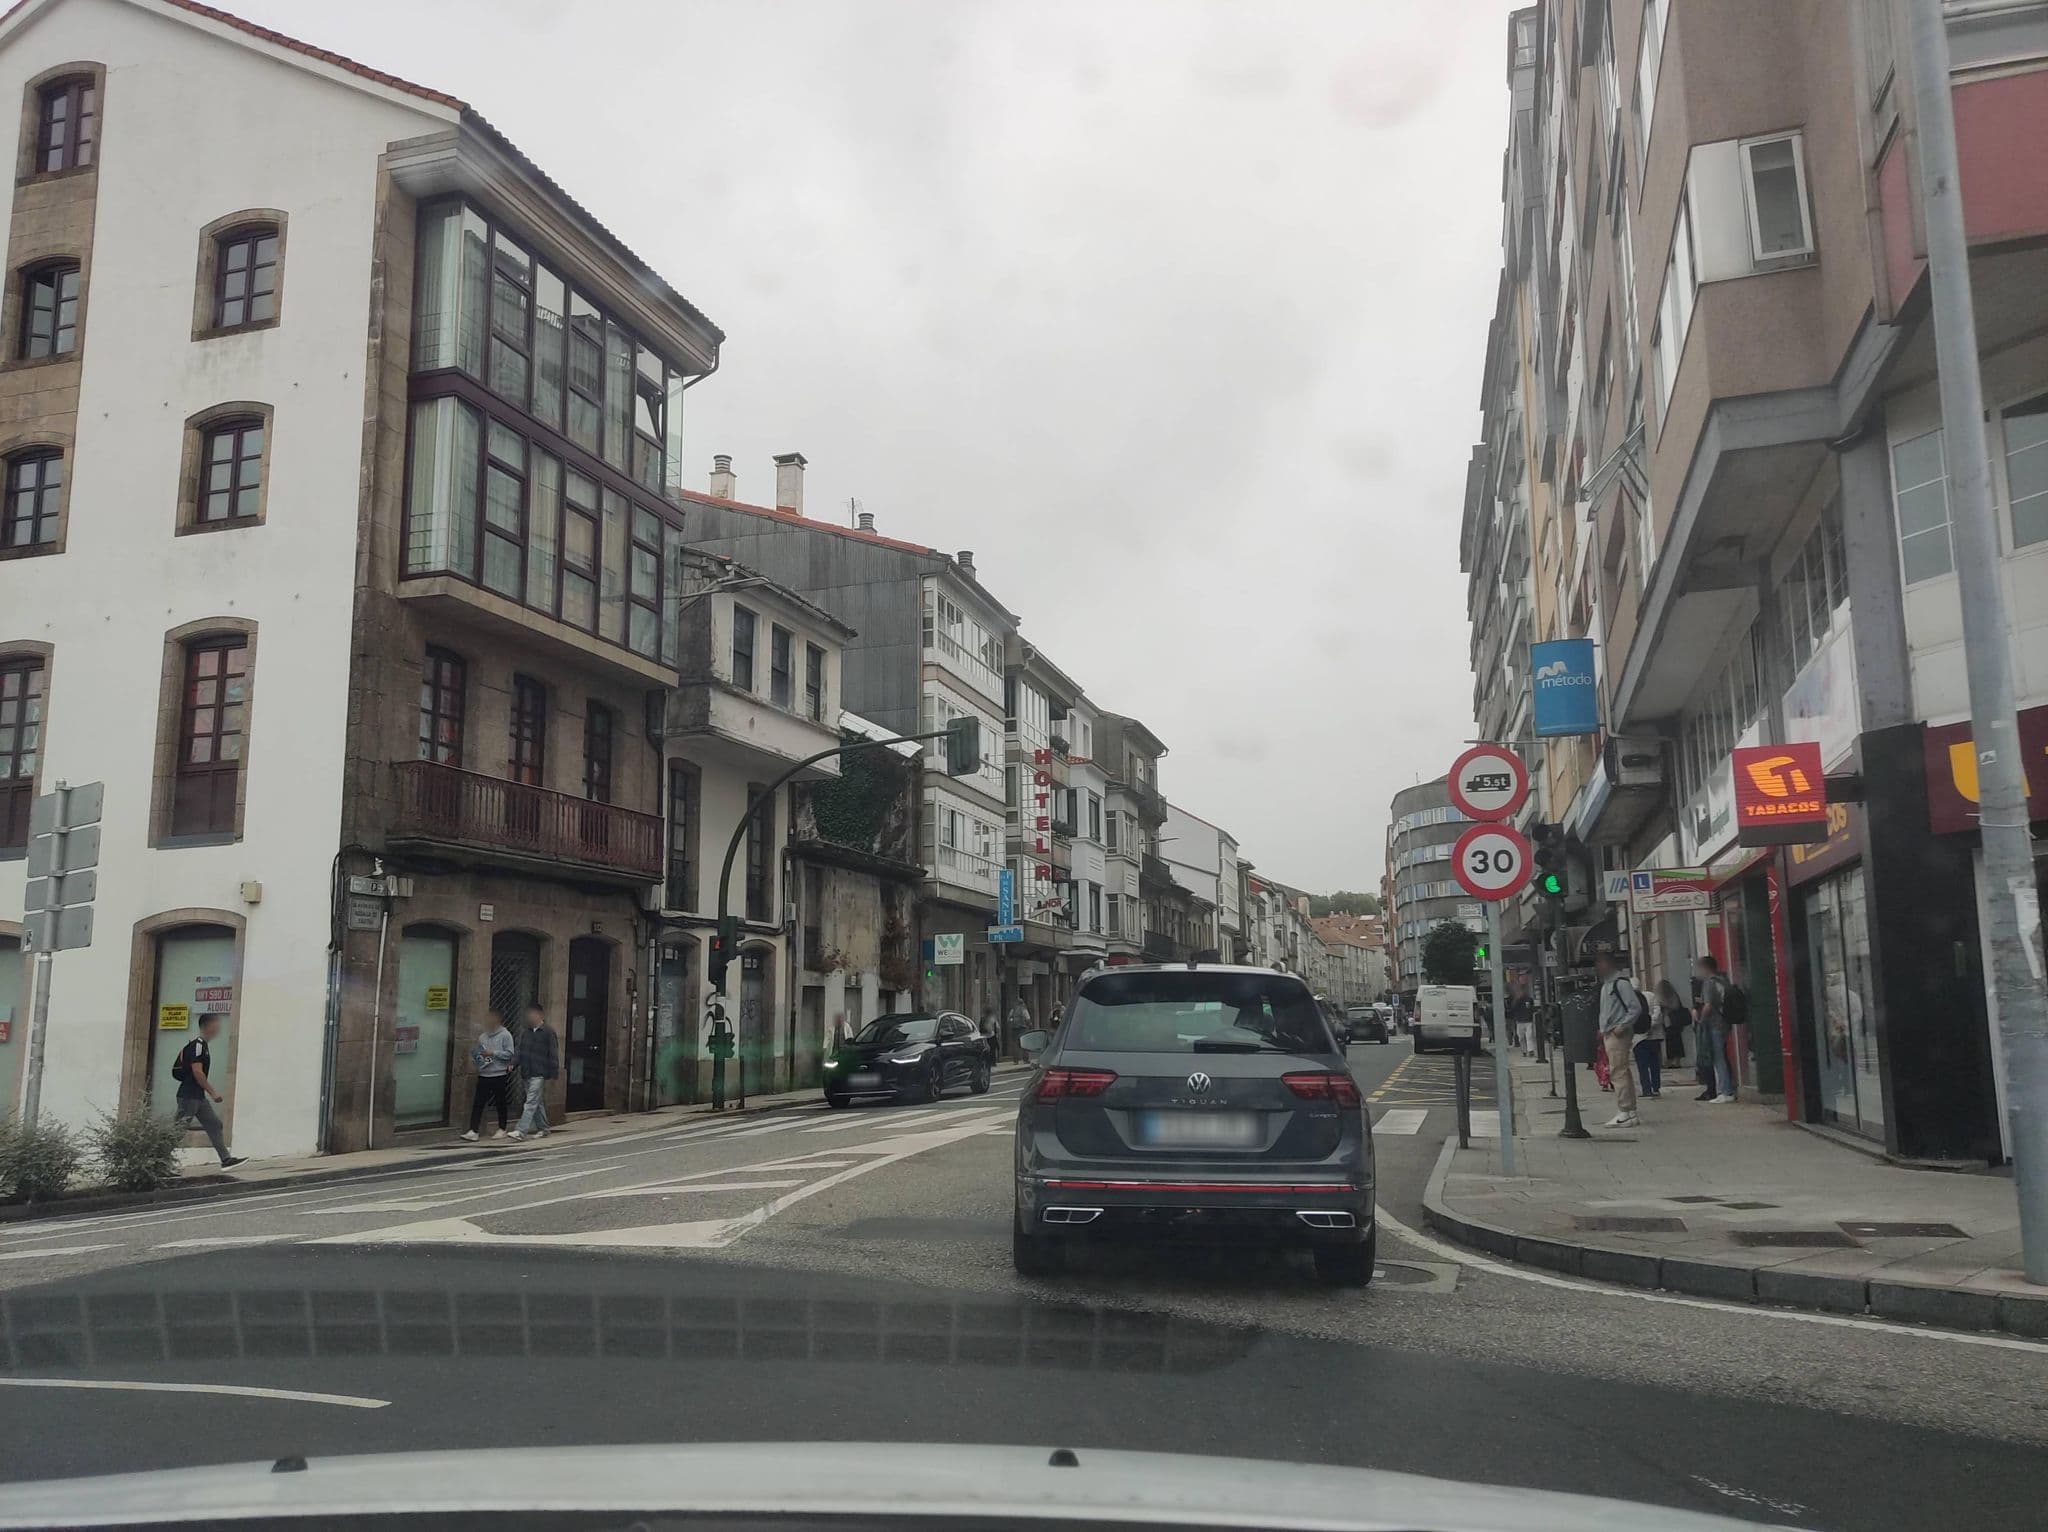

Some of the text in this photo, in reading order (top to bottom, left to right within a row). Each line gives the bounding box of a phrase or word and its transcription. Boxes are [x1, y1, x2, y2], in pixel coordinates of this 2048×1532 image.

[1541, 672, 1592, 688] método
[1034, 749, 1051, 854] HOTEL
[1745, 800, 1821, 816] TABACOS
[1470, 849, 1514, 874] 30
